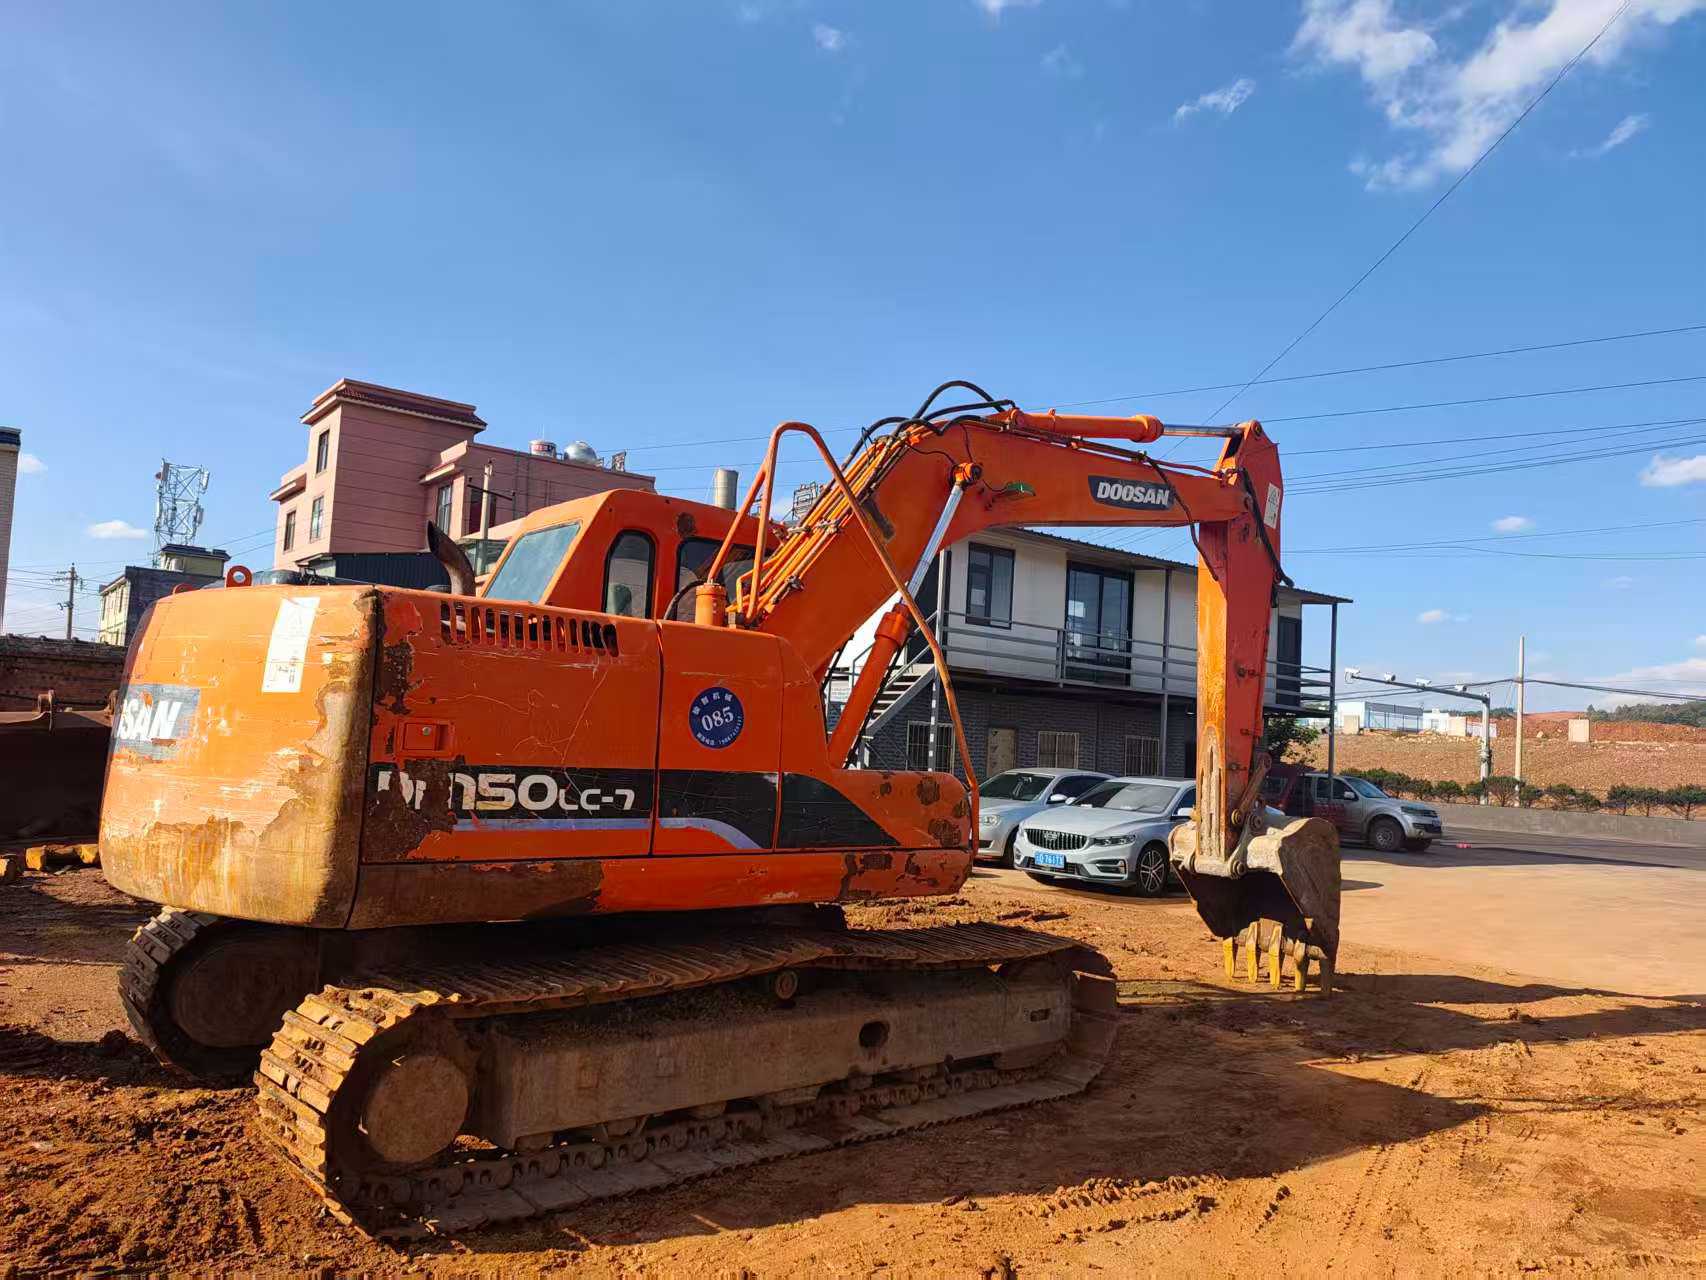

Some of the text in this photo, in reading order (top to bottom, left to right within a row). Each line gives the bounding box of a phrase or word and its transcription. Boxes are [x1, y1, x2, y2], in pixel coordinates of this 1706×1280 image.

[1097, 482, 1170, 505] DOOSAN
[117, 699, 183, 740] SAN
[702, 706, 734, 731] 085
